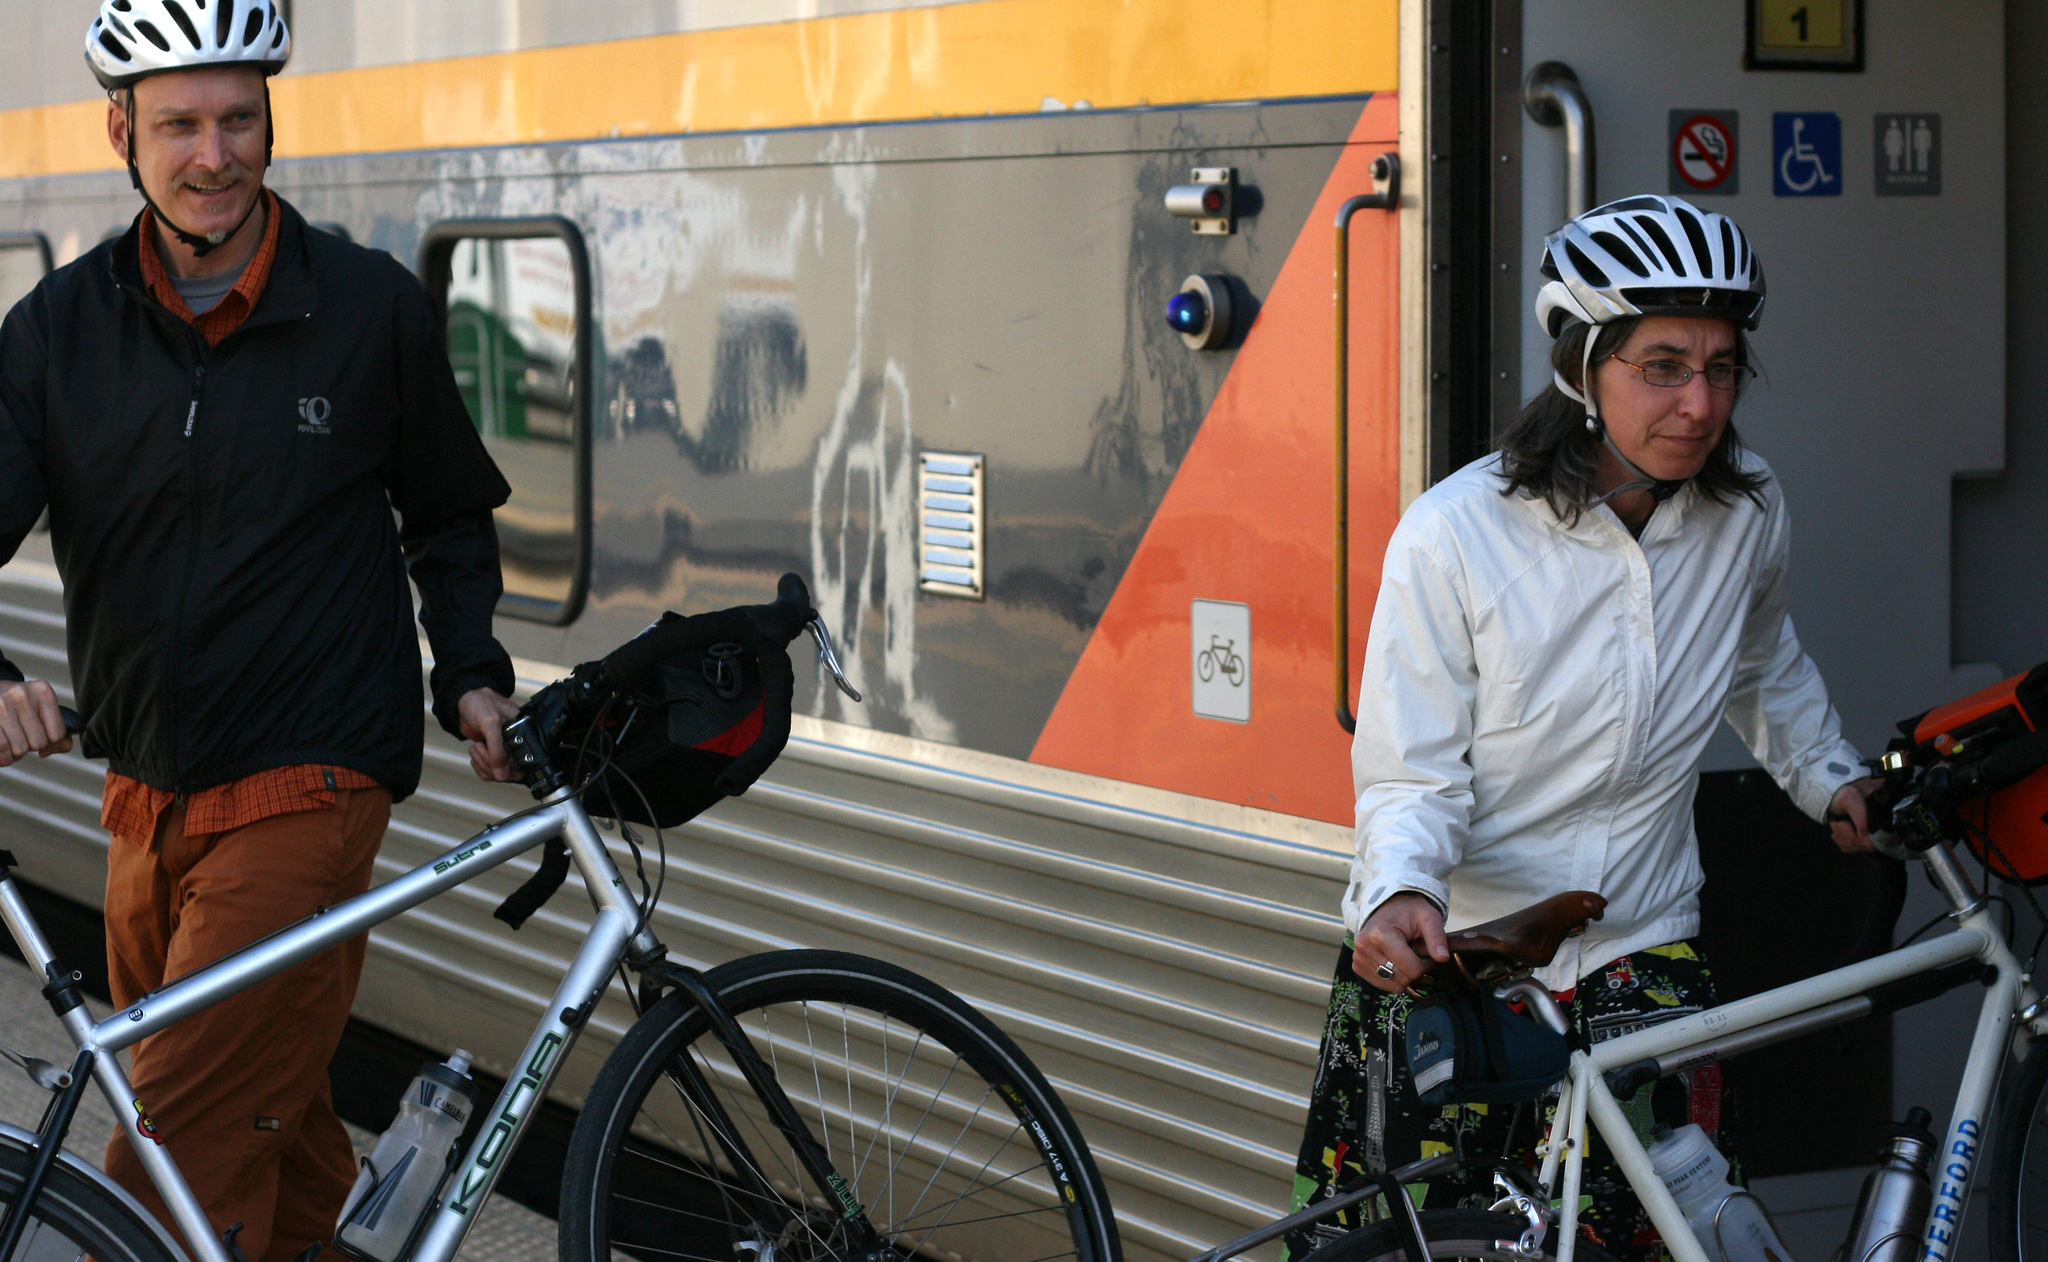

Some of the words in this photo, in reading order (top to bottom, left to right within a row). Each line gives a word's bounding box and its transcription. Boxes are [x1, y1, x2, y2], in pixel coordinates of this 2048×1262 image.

[1790, 6, 1808, 41] 1
[432, 840, 493, 876] Sutra
[450, 1032, 563, 1216] KONA
[1031, 1120, 1053, 1151] DISC
[1048, 1152, 1064, 1172] 317
[1060, 1172, 1069, 1182] A
